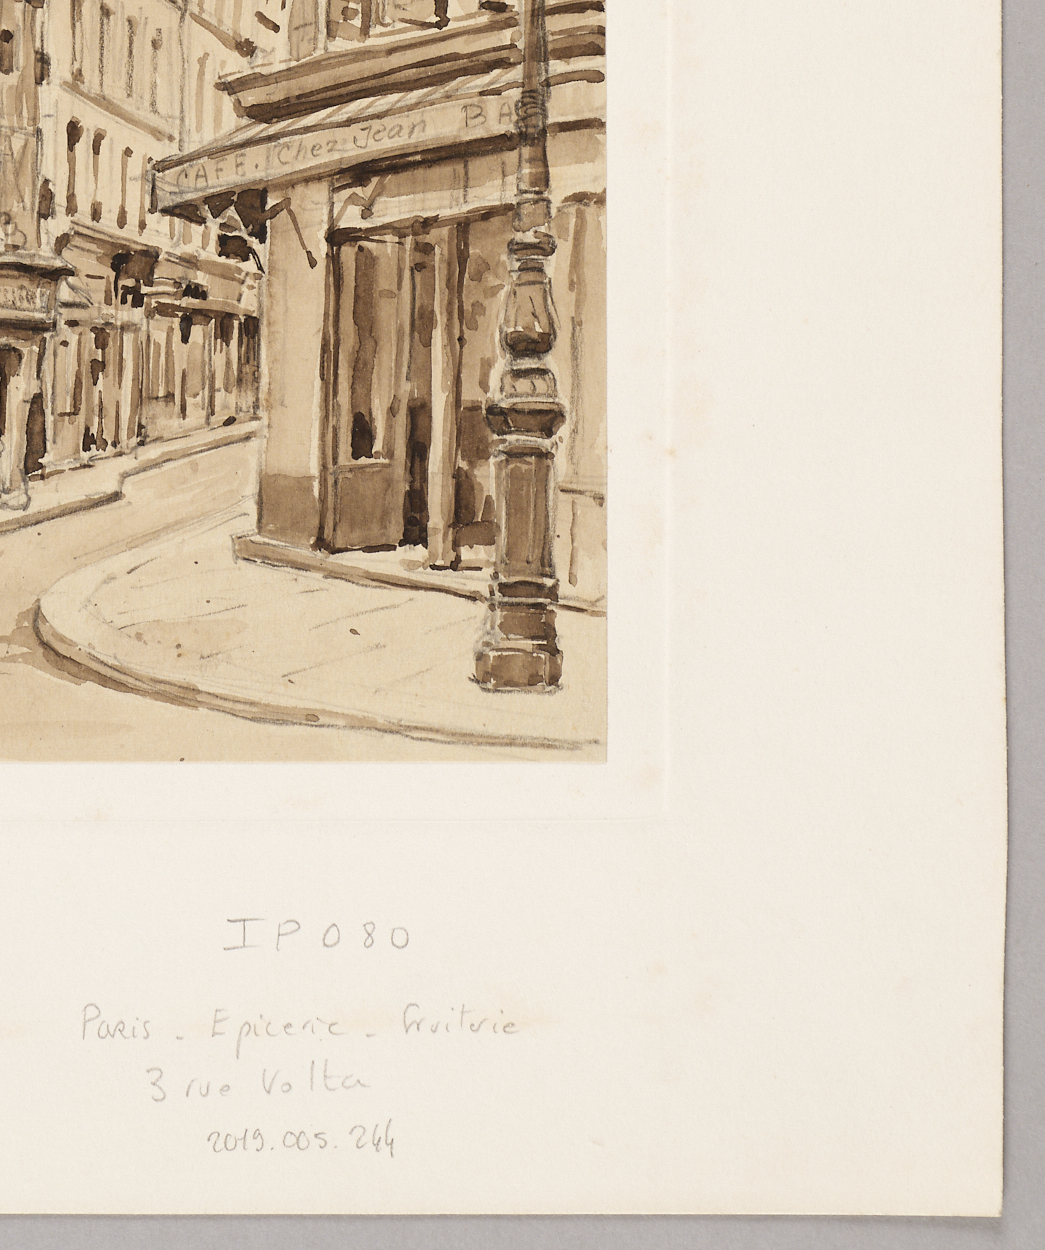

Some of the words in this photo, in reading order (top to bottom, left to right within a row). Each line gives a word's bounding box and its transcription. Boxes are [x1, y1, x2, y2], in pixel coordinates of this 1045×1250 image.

[276, 136, 340, 166] Chez
[352, 120, 427, 149] Jean
[81, 1002, 151, 1041] Paris
[145, 1066, 167, 1103] 3
[184, 1078, 231, 1099] rue
[261, 1058, 371, 1096] Volta
